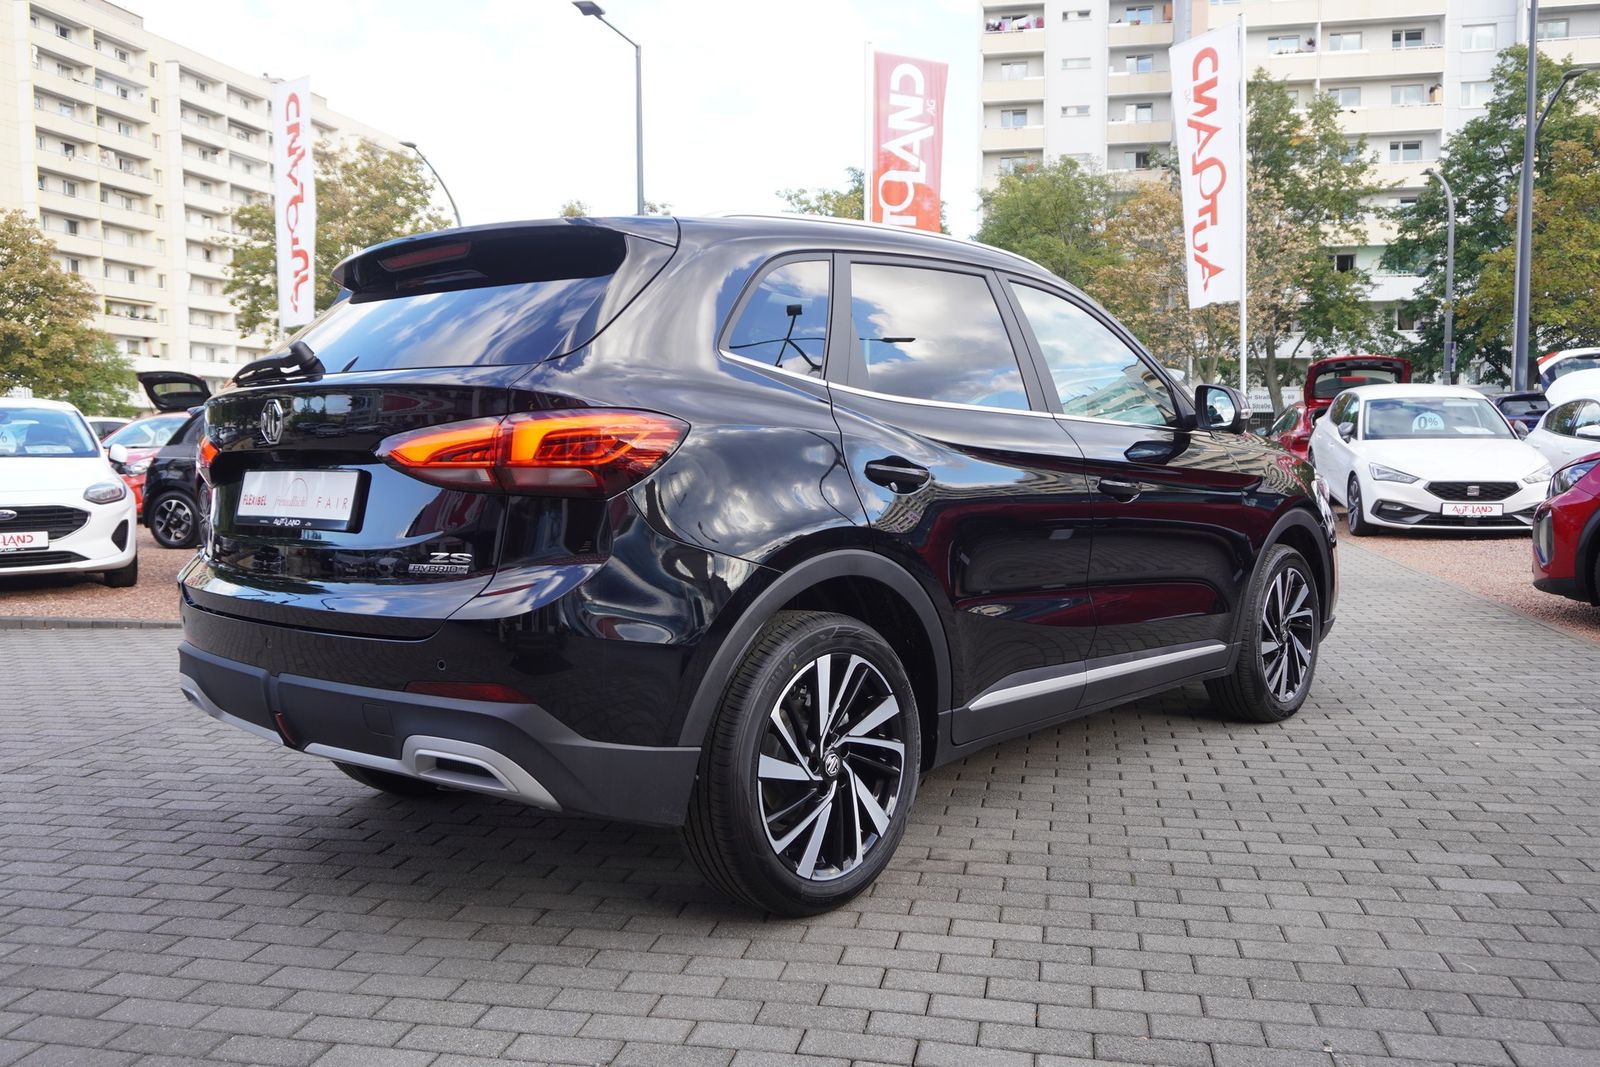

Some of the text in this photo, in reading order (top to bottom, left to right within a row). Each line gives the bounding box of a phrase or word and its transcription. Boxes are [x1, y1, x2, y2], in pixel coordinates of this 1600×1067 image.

[879, 63, 934, 226] TOLAND
[1418, 416, 1438, 429] 0%
[242, 494, 267, 506] FLEXIBEL
[1, 534, 34, 547] LAND
[429, 552, 473, 564] ZS
